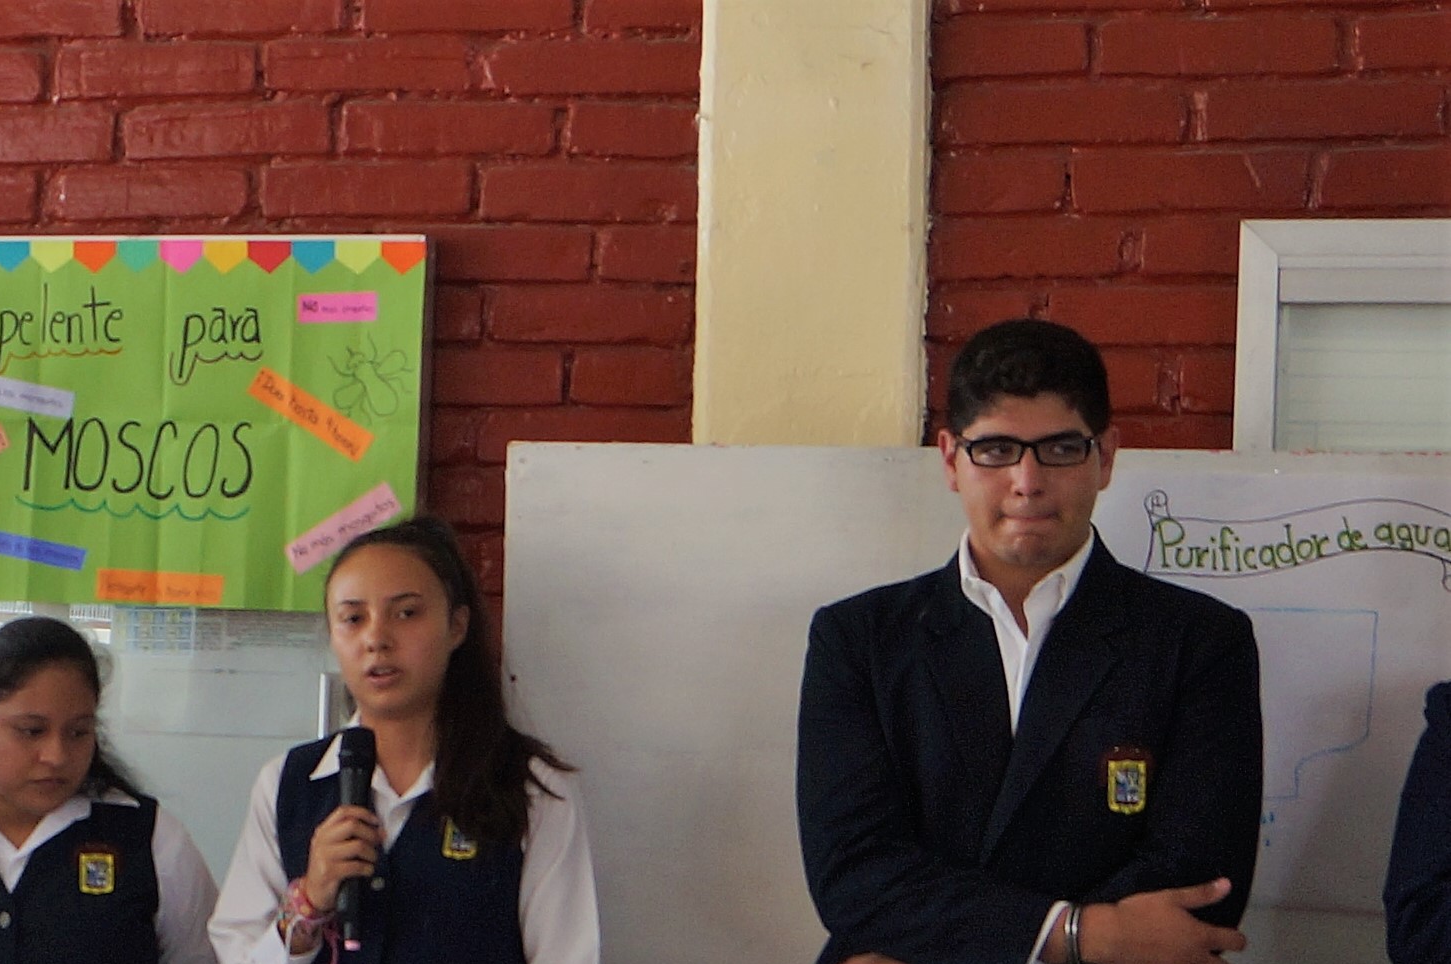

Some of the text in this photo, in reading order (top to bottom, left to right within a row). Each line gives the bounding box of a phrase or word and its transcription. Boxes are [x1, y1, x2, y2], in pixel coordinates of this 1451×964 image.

[178, 306, 263, 378] para
[23, 417, 254, 500] MOSCOS
[1154, 515, 1451, 572] Purificador de agua
